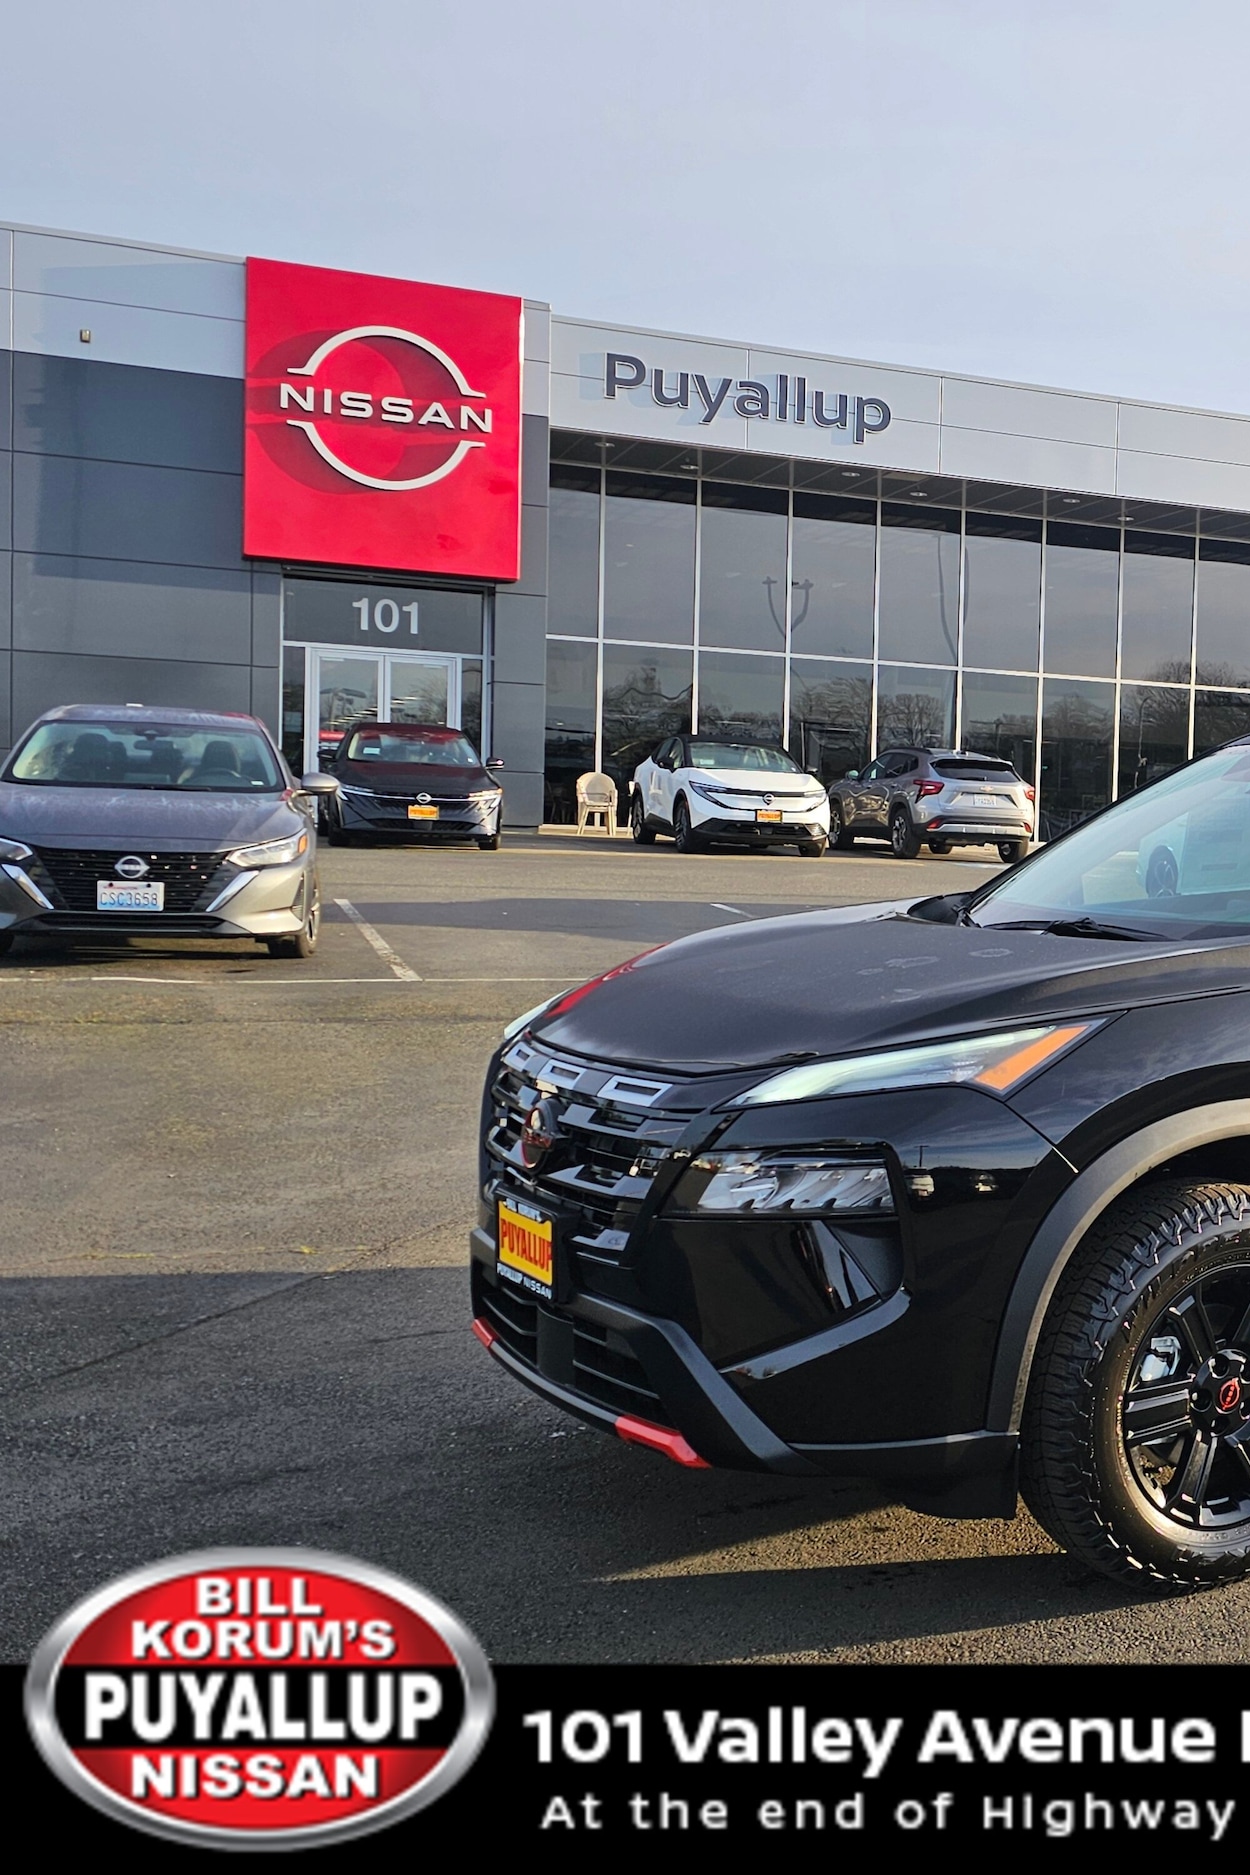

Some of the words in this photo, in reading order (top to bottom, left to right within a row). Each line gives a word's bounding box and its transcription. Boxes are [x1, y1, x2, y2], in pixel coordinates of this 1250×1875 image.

[279, 382, 493, 434] NISSAN
[603, 352, 892, 445] Puyallup
[352, 597, 420, 635] 101
